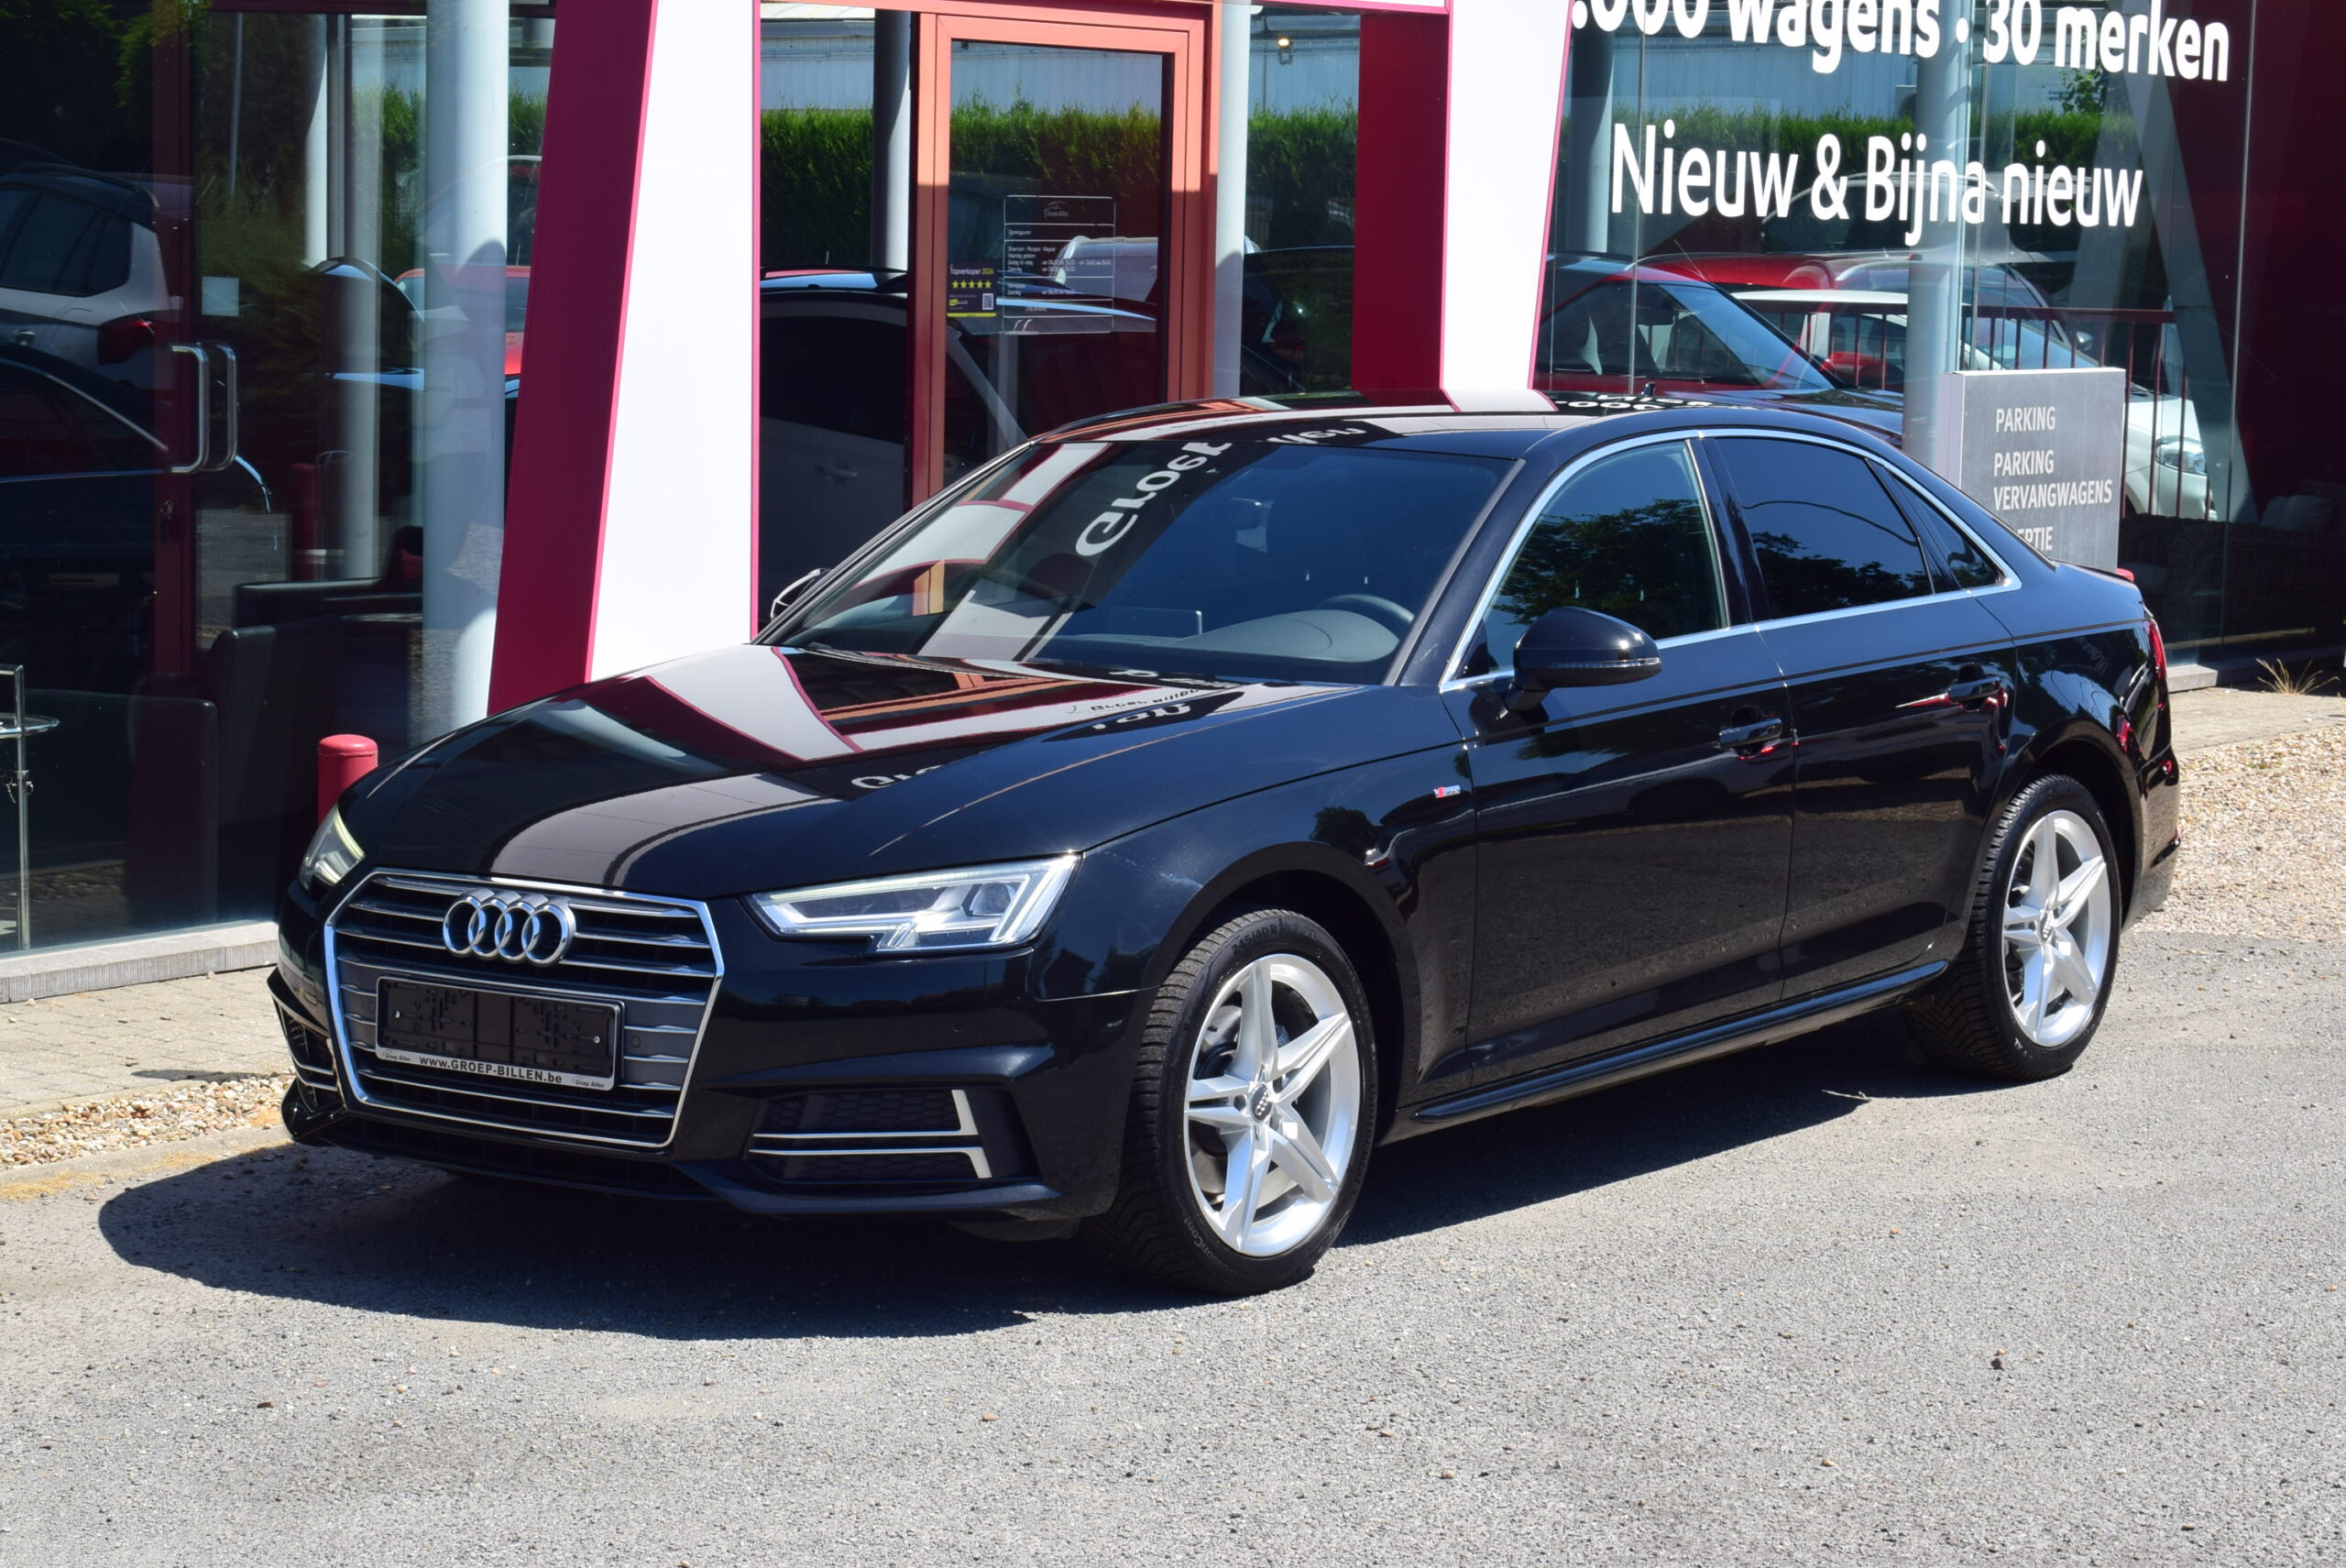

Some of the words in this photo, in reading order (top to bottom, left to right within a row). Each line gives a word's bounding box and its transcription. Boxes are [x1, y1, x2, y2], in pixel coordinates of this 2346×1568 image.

[1727, 0, 1940, 73] wagens
[1983, 0, 2042, 66] 30
[2055, 0, 2230, 82] merken
[1611, 119, 1799, 217] Nieuw
[1811, 133, 1848, 222] &
[1865, 132, 1986, 247] Bijna
[2001, 139, 2143, 227] nieuw
[1995, 406, 2056, 433] PARKING
[1993, 450, 2055, 477] PARKING
[1993, 479, 2113, 510] VERVANGWAGENS
[419, 1056, 563, 1083] www.GROEP-BILLEN.be
